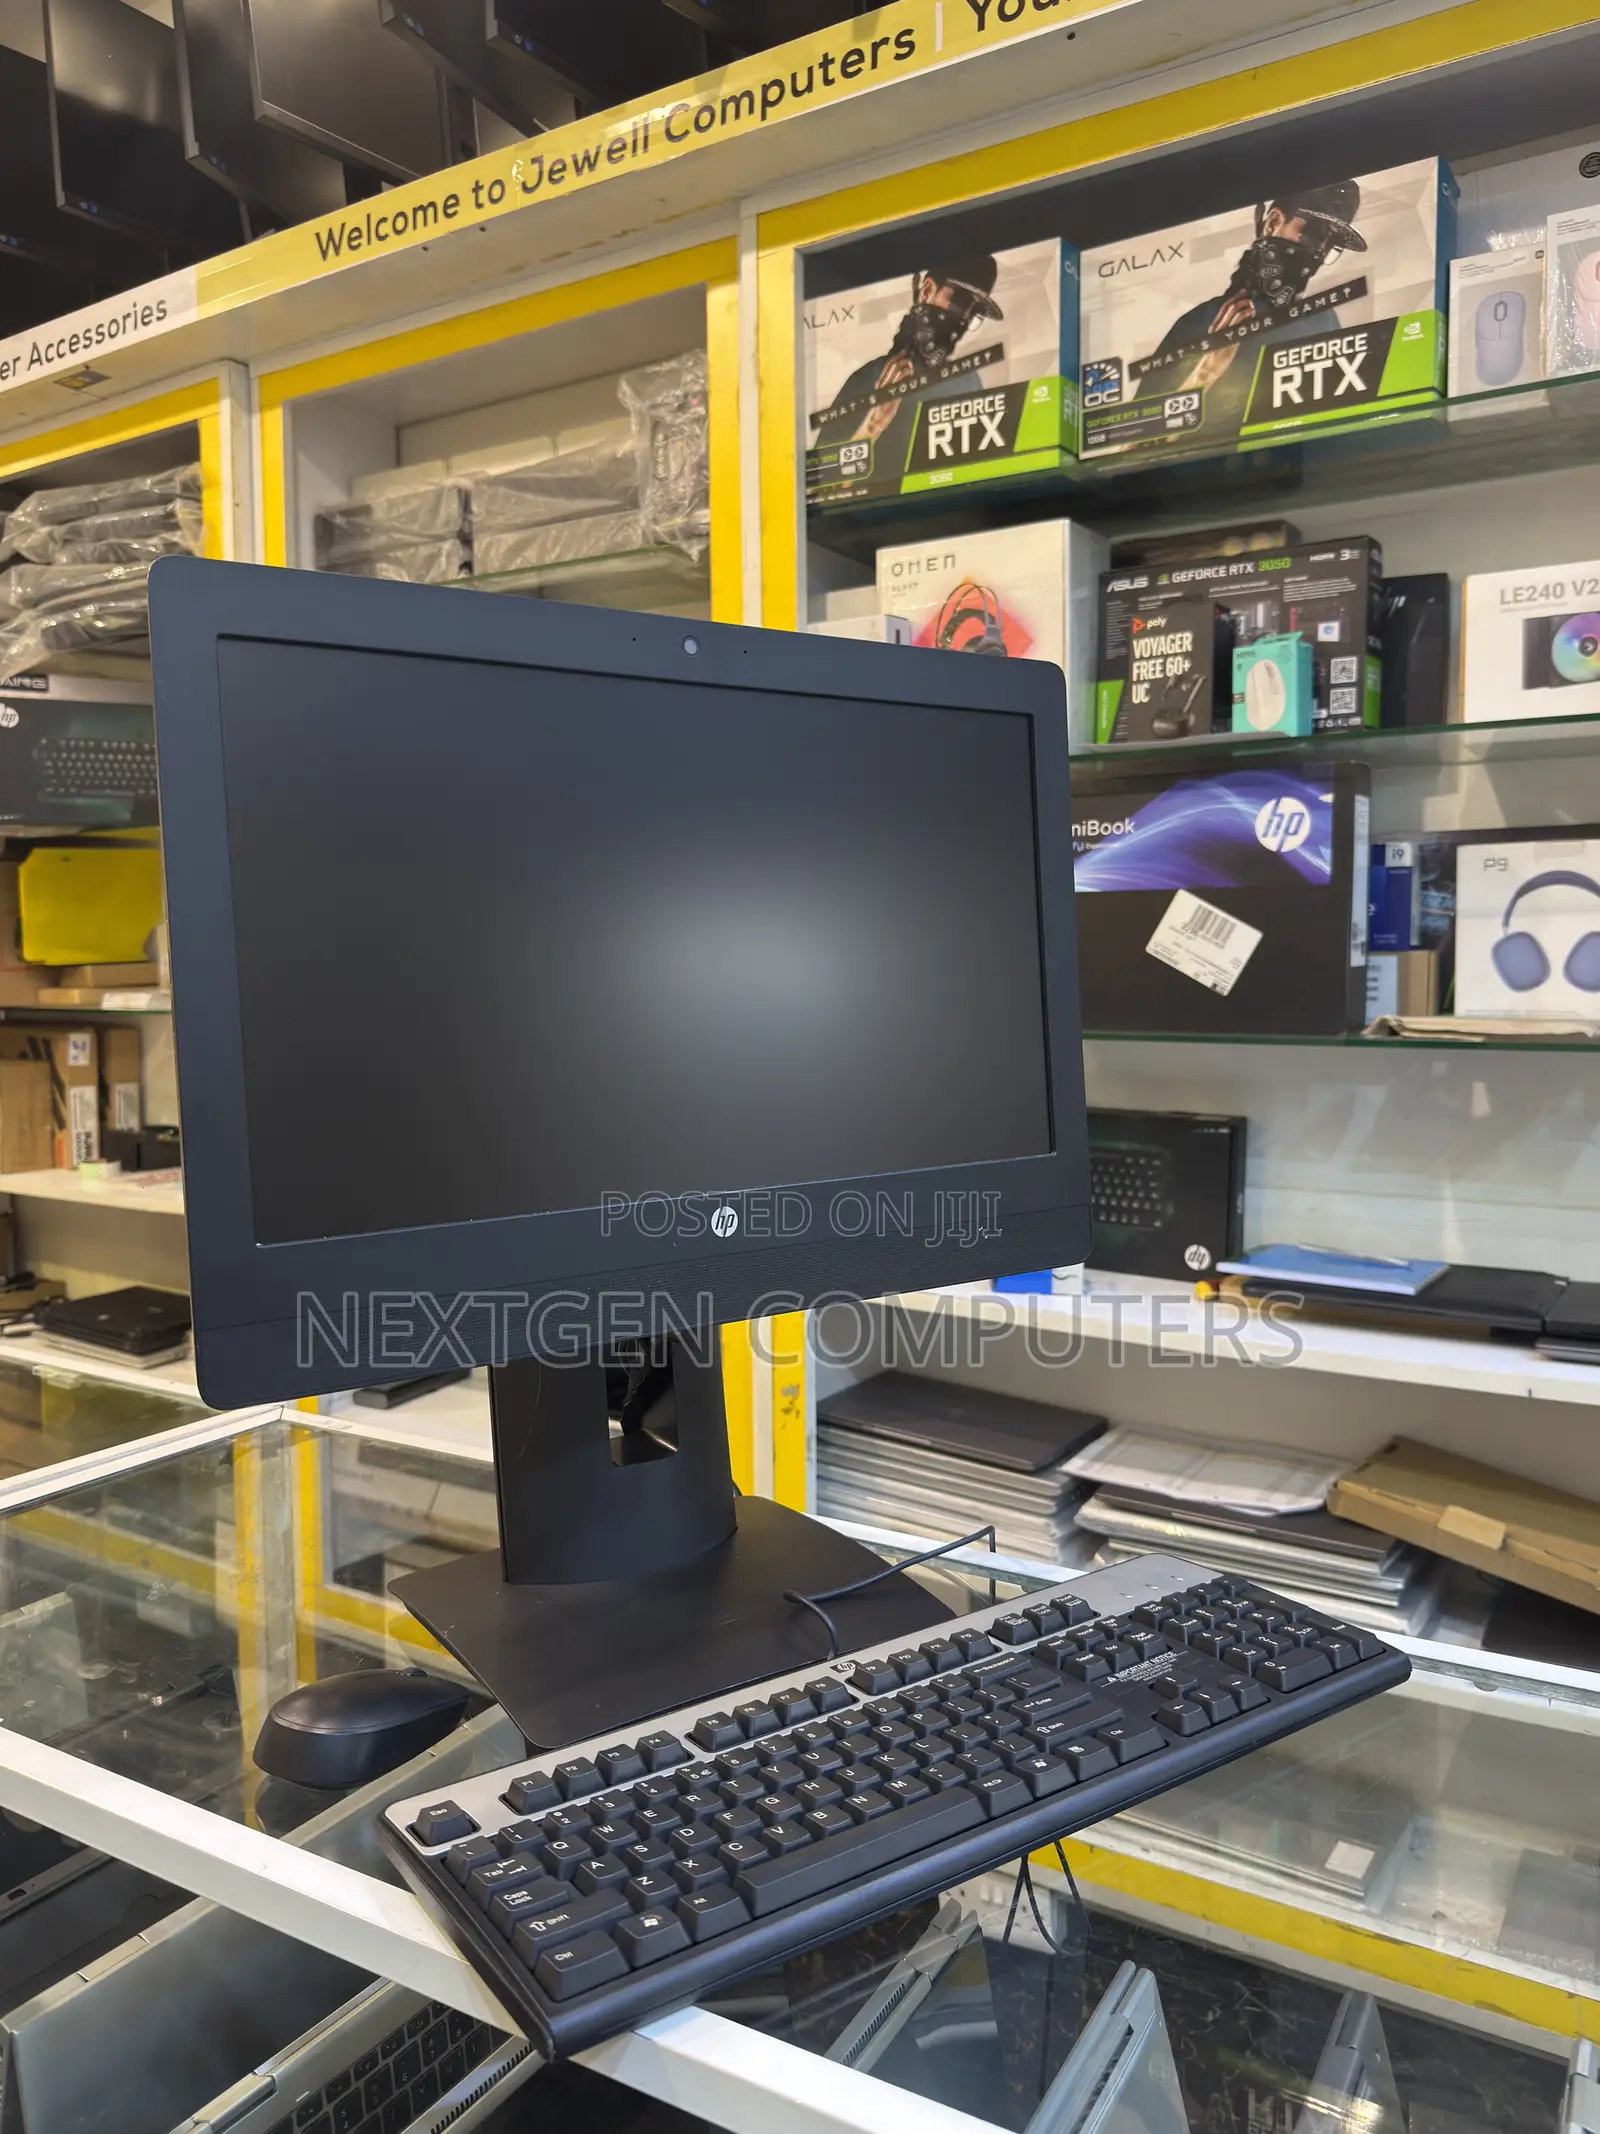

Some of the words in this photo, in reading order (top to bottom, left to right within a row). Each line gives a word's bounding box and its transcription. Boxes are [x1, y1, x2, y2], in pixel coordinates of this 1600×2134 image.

[315, 193, 460, 262] Welcome
[471, 176, 506, 210] to
[521, 113, 649, 194] Jewell
[664, 28, 917, 144] Computers
[1098, 242, 1184, 278] GALAX
[27, 300, 168, 371] Accessories
[1140, 340, 1210, 373] WHAT'S
[1225, 317, 1273, 340] YOUR
[1289, 286, 1352, 318] GAME?
[1273, 332, 1368, 369] GEFORCE
[1272, 352, 1368, 409] RTX
[819, 395, 877, 424] WHAT'S
[889, 375, 928, 397] YOUR
[940, 352, 992, 378] GAME?
[1084, 388, 1120, 407] OC
[928, 394, 1006, 424] GEFORCE
[928, 411, 1006, 460] RTX
[891, 554, 957, 577] OMEN
[1106, 576, 1149, 593] ASUS
[1172, 563, 1227, 584] GEFORCE
[1229, 562, 1255, 576] RTX
[1258, 557, 1292, 572] 3050
[1500, 582, 1565, 605] LE240
[1147, 616, 1168, 629] poly
[1132, 631, 1193, 659] VOYAGER
[1132, 658, 1164, 682] FREE
[1165, 655, 1192, 677] 60+
[1131, 681, 1151, 704] UC
[1257, 797, 1309, 852] hp
[1483, 857, 1508, 872] P9
[712, 1206, 738, 1237] hp
[1114, 1659, 1153, 1678] IMPORTANT
[1149, 1651, 1177, 1665] NOTICE
[805, 1752, 820, 1760] U
[880, 1754, 895, 1762] K
[767, 1765, 780, 1773] Y
[804, 1782, 820, 1790] H
[890, 1780, 907, 1789] M
[686, 1794, 701, 1803] R
[851, 1795, 868, 1803] N
[643, 1809, 658, 1818] E
[722, 1812, 734, 1820] F
[812, 1811, 828, 1819] B
[598, 1825, 615, 1834] W
[679, 1828, 695, 1837] D
[770, 1826, 784, 1834] V
[552, 1841, 569, 1850] Q
[634, 1845, 648, 1853] S
[728, 1842, 743, 1851] C
[590, 1861, 604, 1870] A
[683, 1859, 699, 1868] X
[483, 1869, 503, 1878] Tab
[636, 1876, 653, 1886] Z
[503, 1889, 528, 1901] Caps
[508, 1895, 533, 1905] Lock
[546, 1913, 570, 1926] Shift
[554, 1951, 574, 1961] Ctrl
